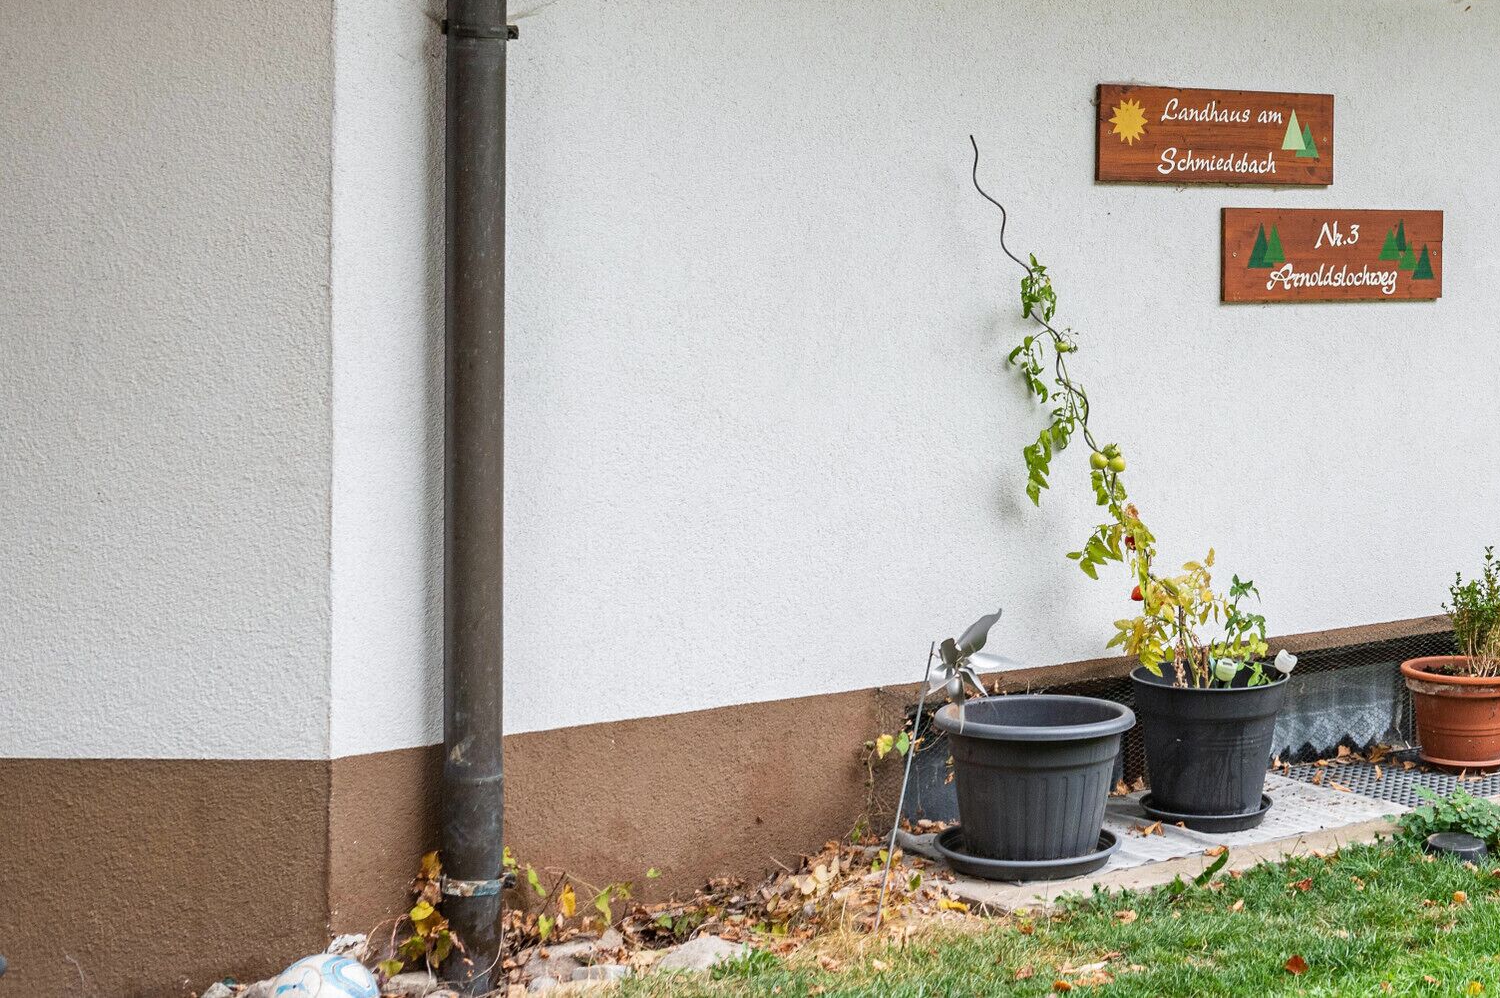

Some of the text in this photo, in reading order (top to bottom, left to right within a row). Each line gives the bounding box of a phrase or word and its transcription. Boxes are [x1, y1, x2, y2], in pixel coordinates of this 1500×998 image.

[1161, 98, 1283, 124] Landhaus am
[1157, 147, 1277, 175] Schmiedebach
[1266, 263, 1398, 294] Arnoldslochweg
